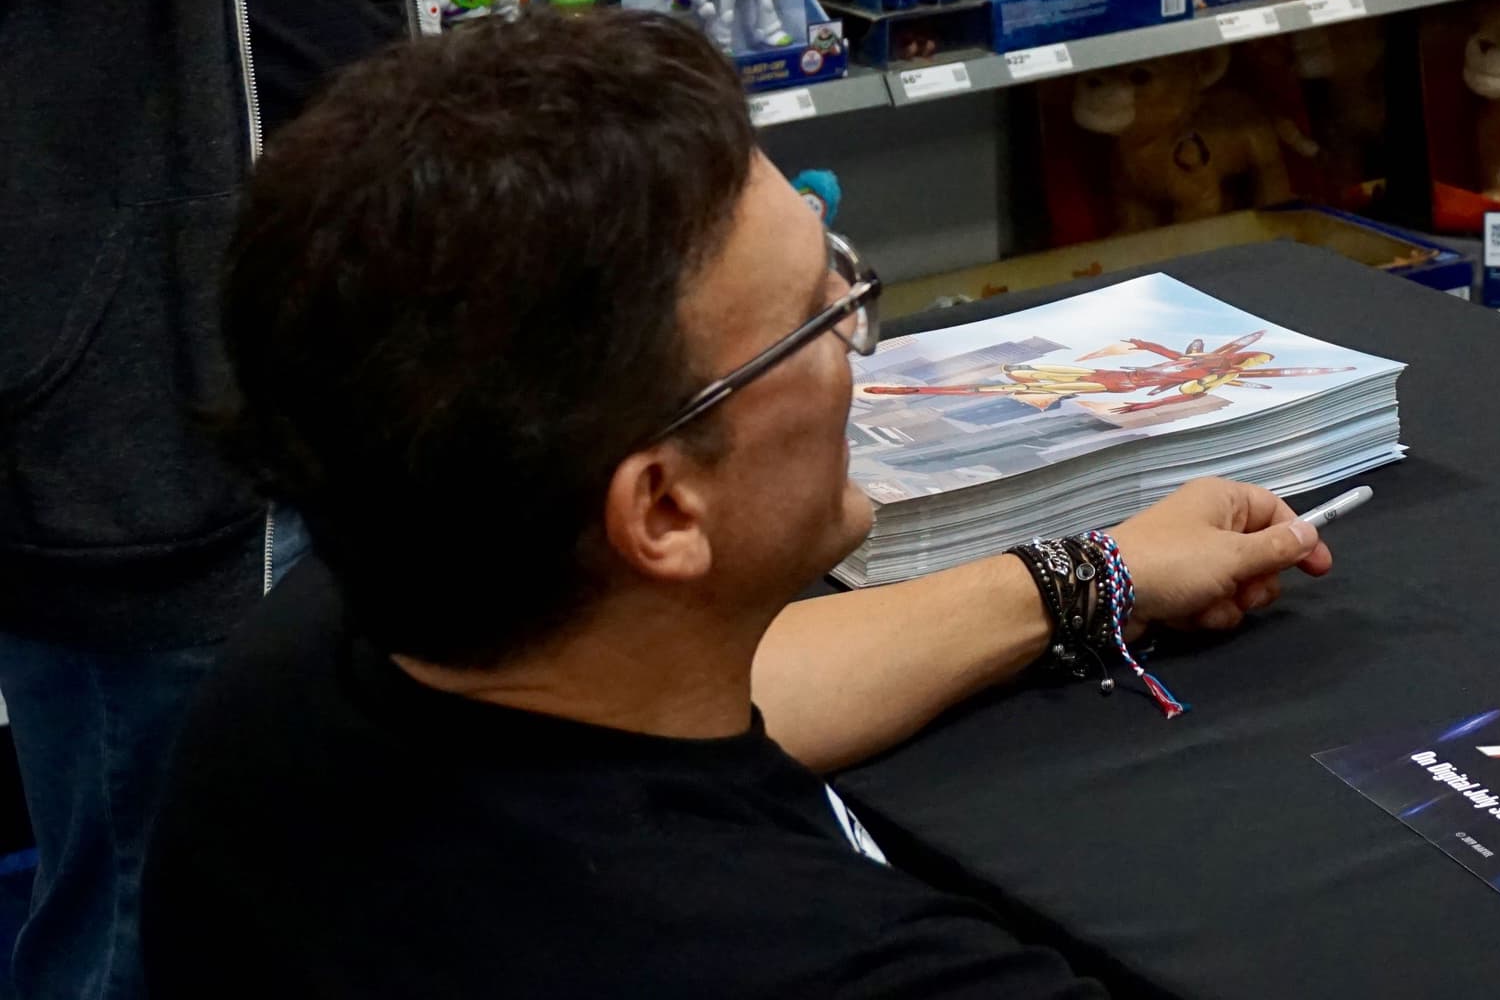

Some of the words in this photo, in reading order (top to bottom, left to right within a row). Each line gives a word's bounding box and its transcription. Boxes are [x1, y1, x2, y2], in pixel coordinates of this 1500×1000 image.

[1410, 750, 1436, 768] On
[1427, 761, 1472, 794] Digital
[1462, 783, 1500, 810] July
